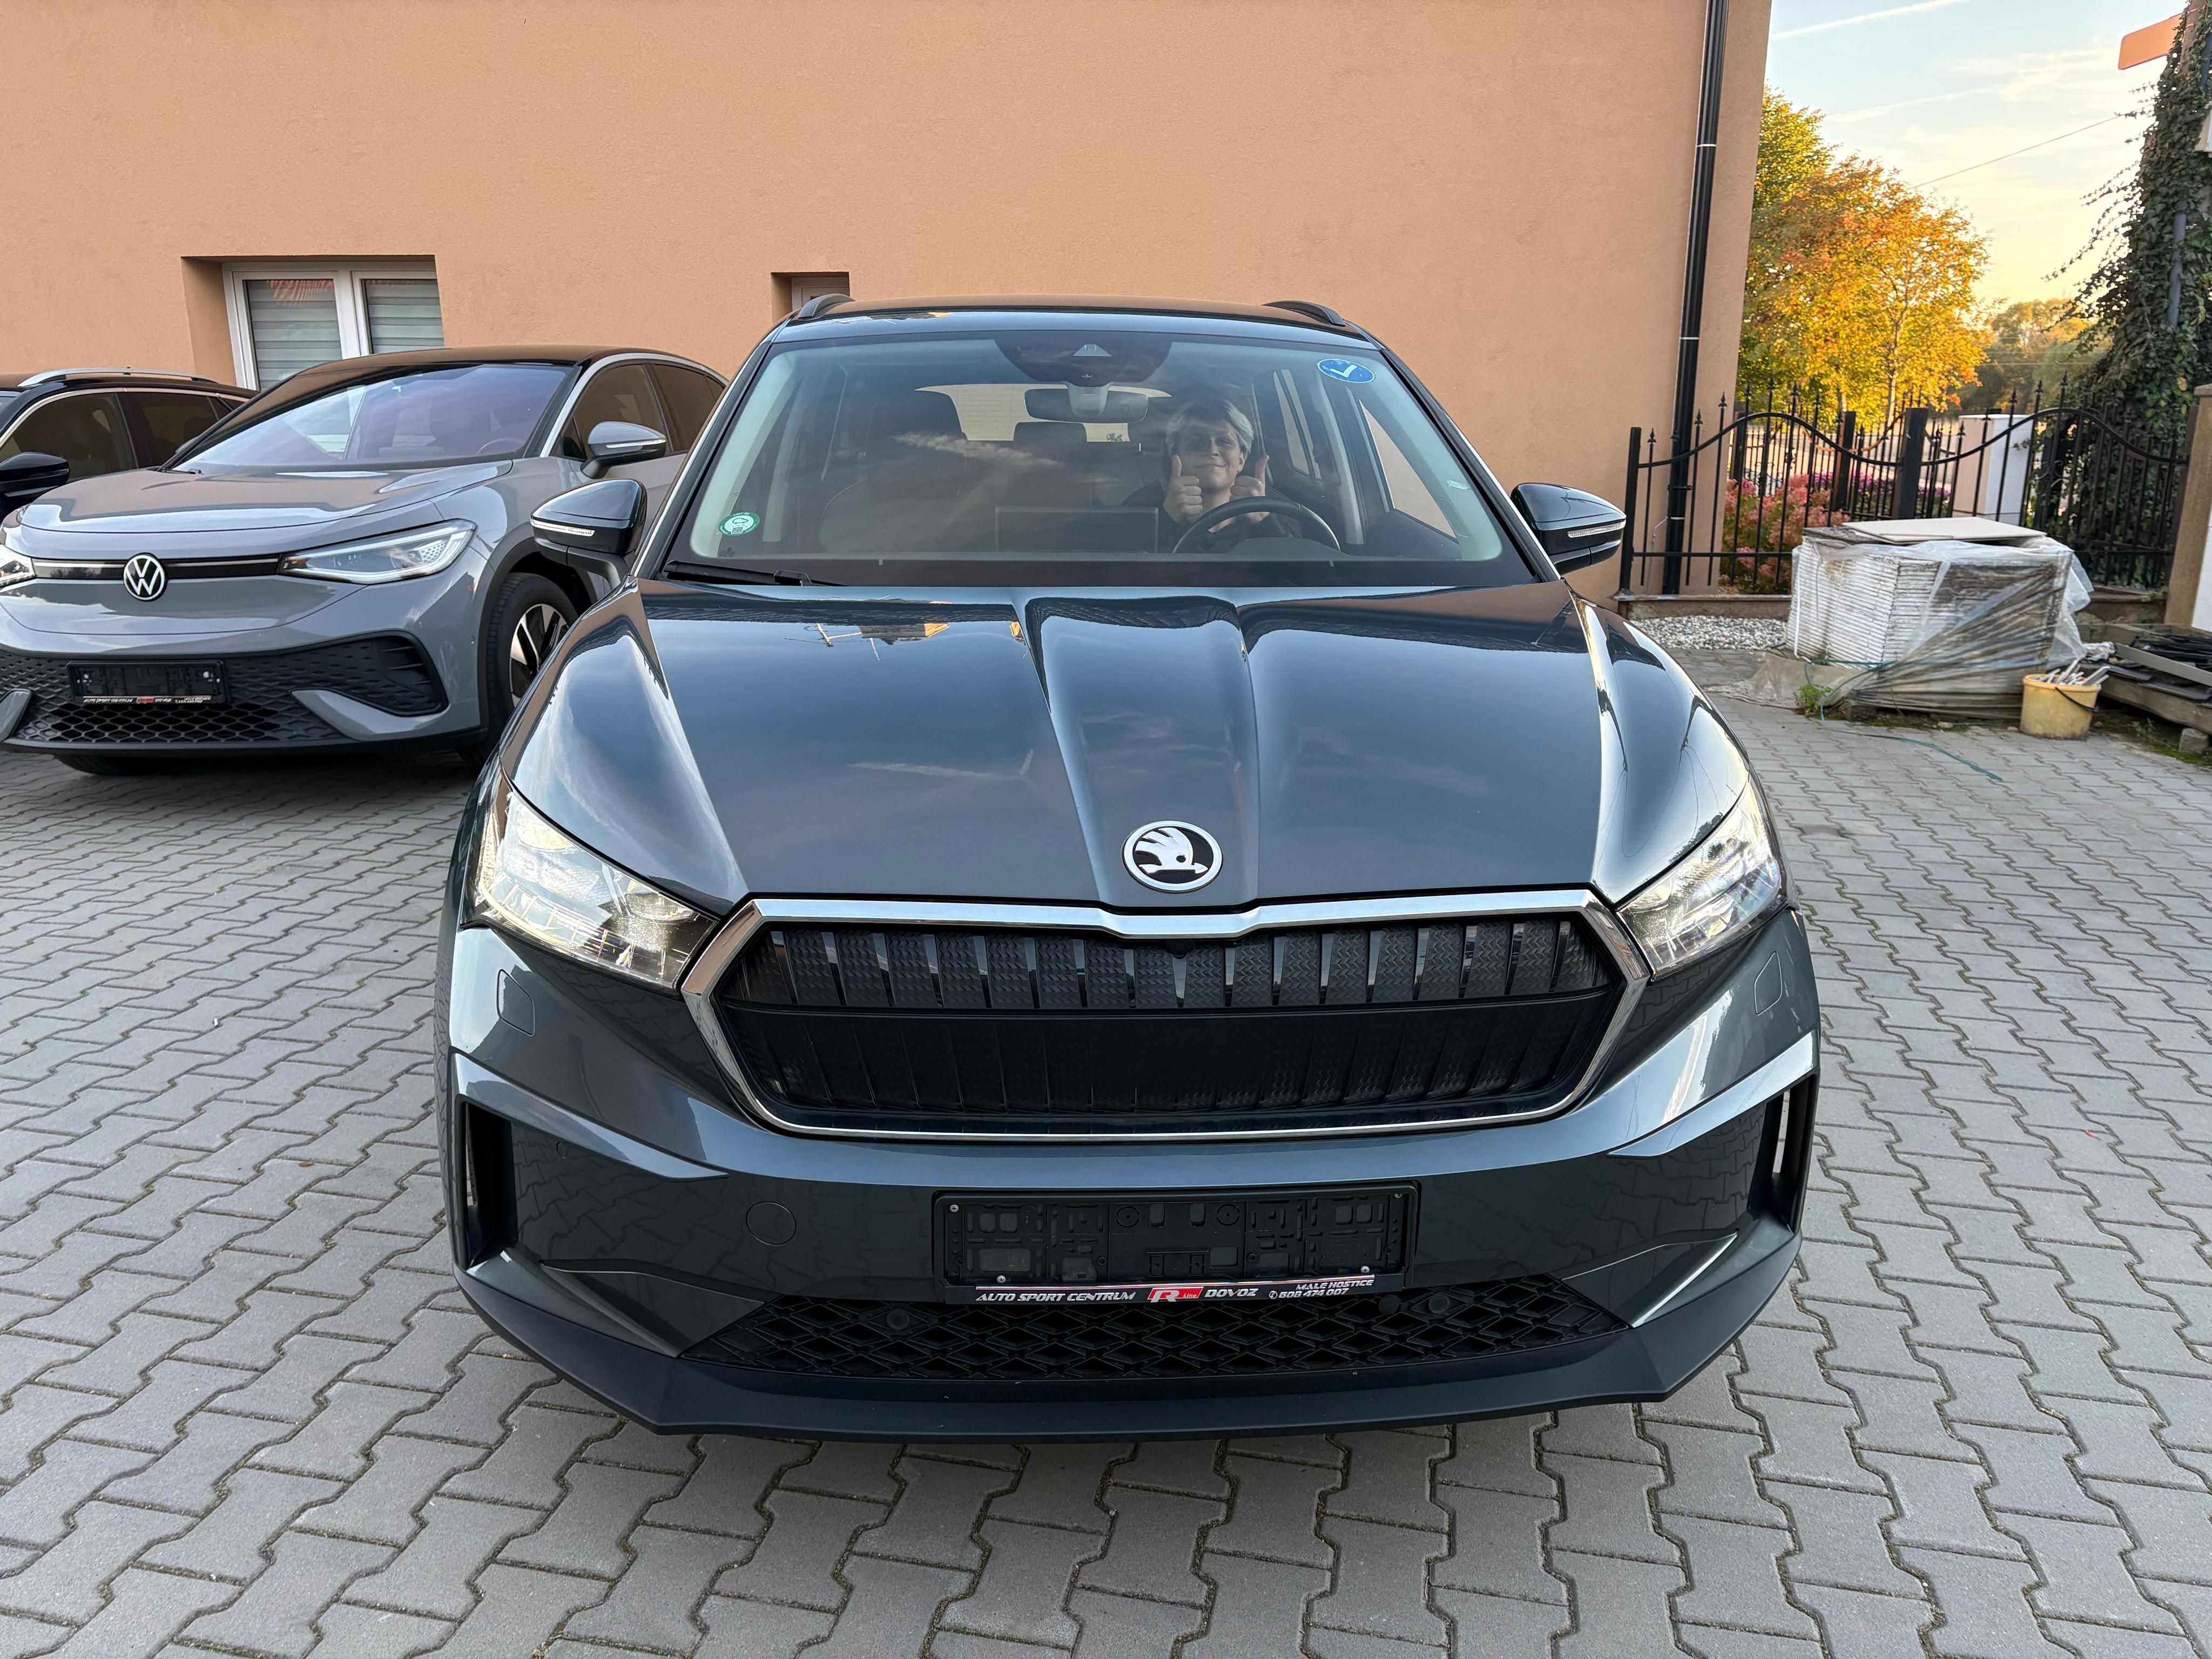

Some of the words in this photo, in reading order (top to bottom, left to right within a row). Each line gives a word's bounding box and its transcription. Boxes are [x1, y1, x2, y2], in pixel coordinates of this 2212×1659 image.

[1017, 1293, 1065, 1301] SPORT
[1067, 1291, 1136, 1301] CENTRUM
[1150, 1290, 1179, 1303] R
[1204, 1288, 1259, 1298] DOVOZ
[1326, 1288, 1350, 1296] 007
